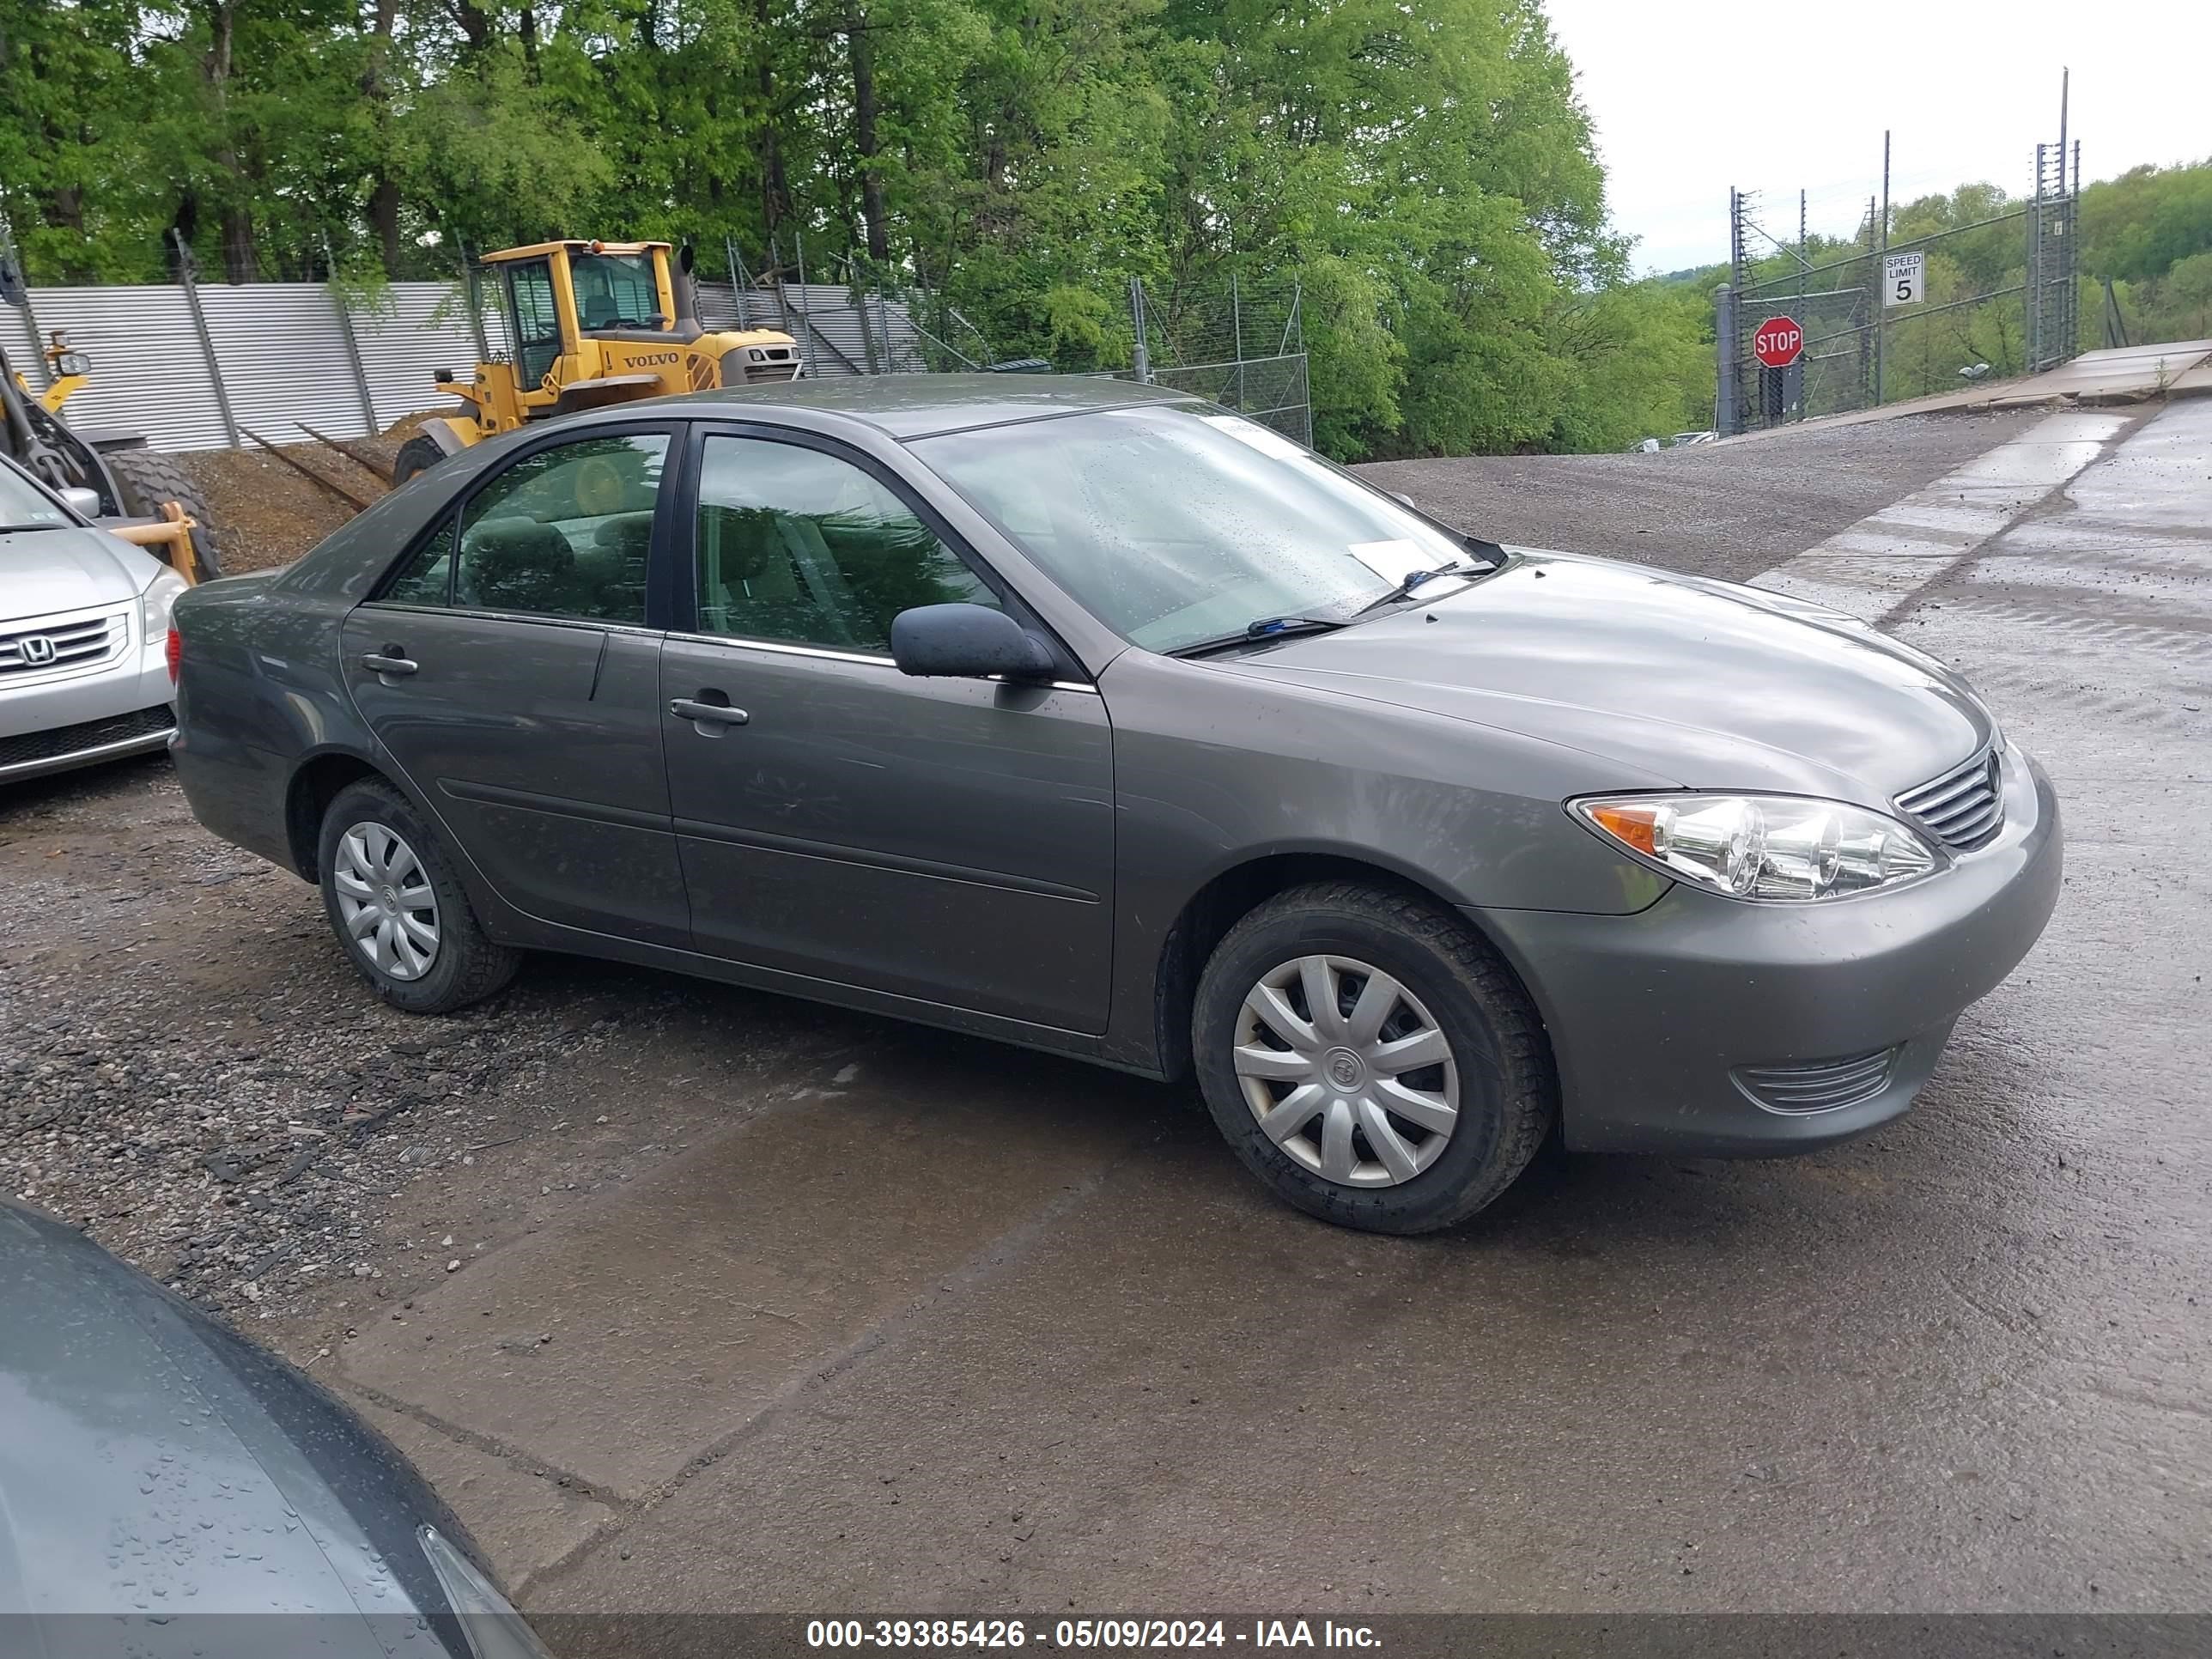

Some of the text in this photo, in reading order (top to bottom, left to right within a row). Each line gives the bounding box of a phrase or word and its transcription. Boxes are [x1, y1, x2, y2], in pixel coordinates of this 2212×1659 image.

[1887, 255, 1921, 268] SPEED
[1889, 266, 1917, 278] LIMIT
[1896, 280, 1911, 301] 5
[1757, 330, 1799, 354] STOP
[623, 352, 678, 368] VOLVO
